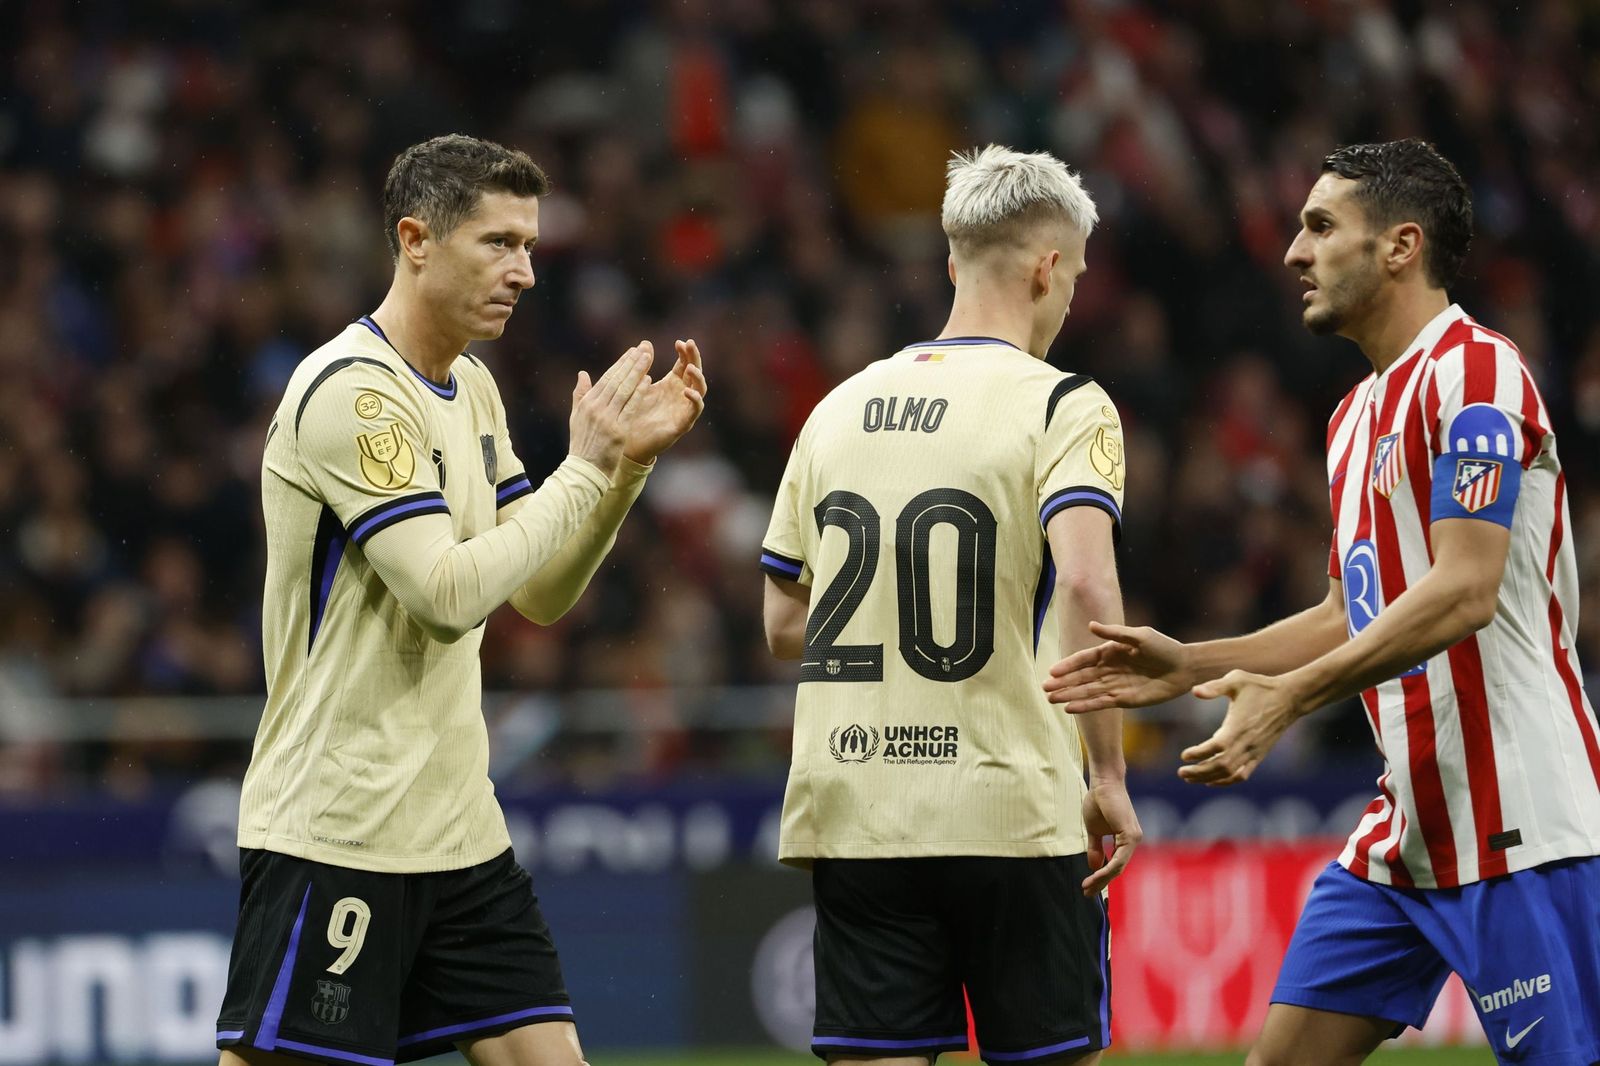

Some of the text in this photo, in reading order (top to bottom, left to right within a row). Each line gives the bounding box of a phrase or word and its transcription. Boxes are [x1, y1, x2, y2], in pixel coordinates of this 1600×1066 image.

[361, 400, 377, 412] 32
[863, 396, 949, 433] OLMO
[800, 488, 998, 683] 20
[883, 742, 957, 757] ACNUR
[885, 726, 959, 741] UNHCR
[326, 896, 371, 975] 9
[1467, 974, 1551, 1013] omAve
